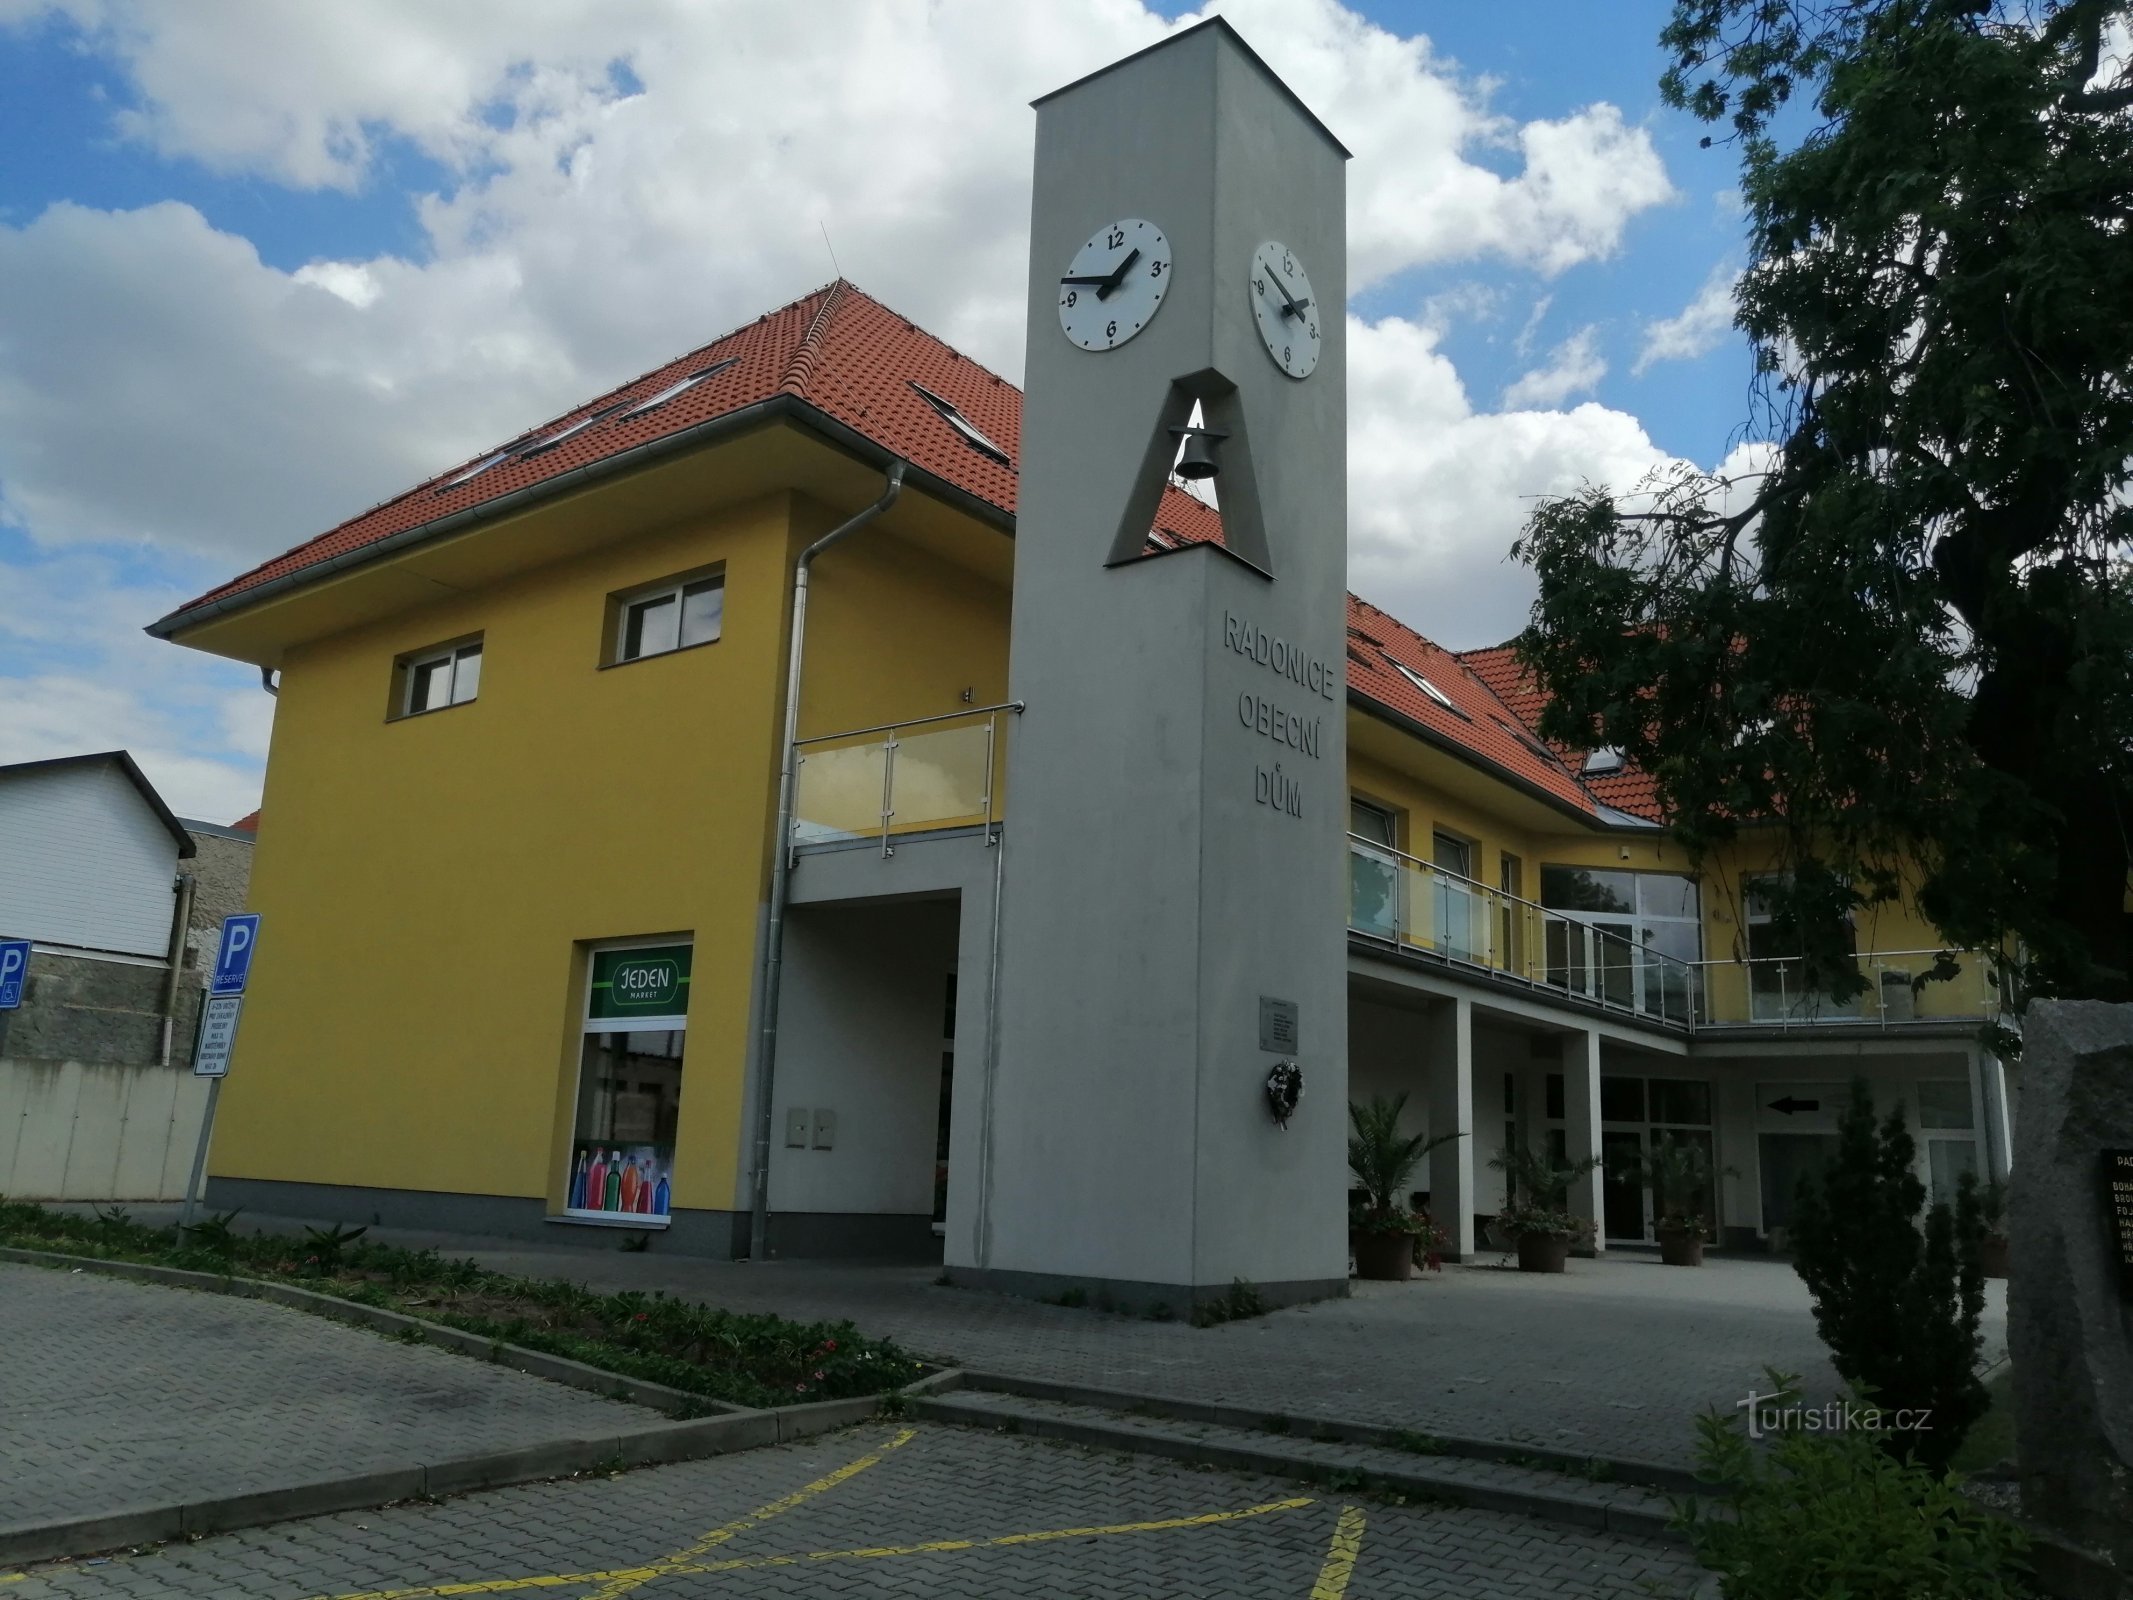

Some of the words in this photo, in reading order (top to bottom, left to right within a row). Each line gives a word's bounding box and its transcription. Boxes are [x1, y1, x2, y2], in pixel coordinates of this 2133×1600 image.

[1107, 230, 1124, 251] 12
[1150, 260, 1162, 277] 3
[1283, 256, 1294, 277] 12
[1257, 279, 1265, 296] 9
[1066, 291, 1077, 307] 9
[1106, 320, 1117, 337] 6
[1309, 322, 1316, 339] 3
[1284, 346, 1291, 362] 6
[1224, 609, 1335, 701] RADONICE
[1239, 690, 1320, 759] OBECNÍ
[1255, 761, 1302, 818] DŮM
[225, 925, 250, 968] P
[0, 949, 22, 986] P
[620, 967, 670, 990] JEDEN
[630, 991, 658, 999] MARKET
